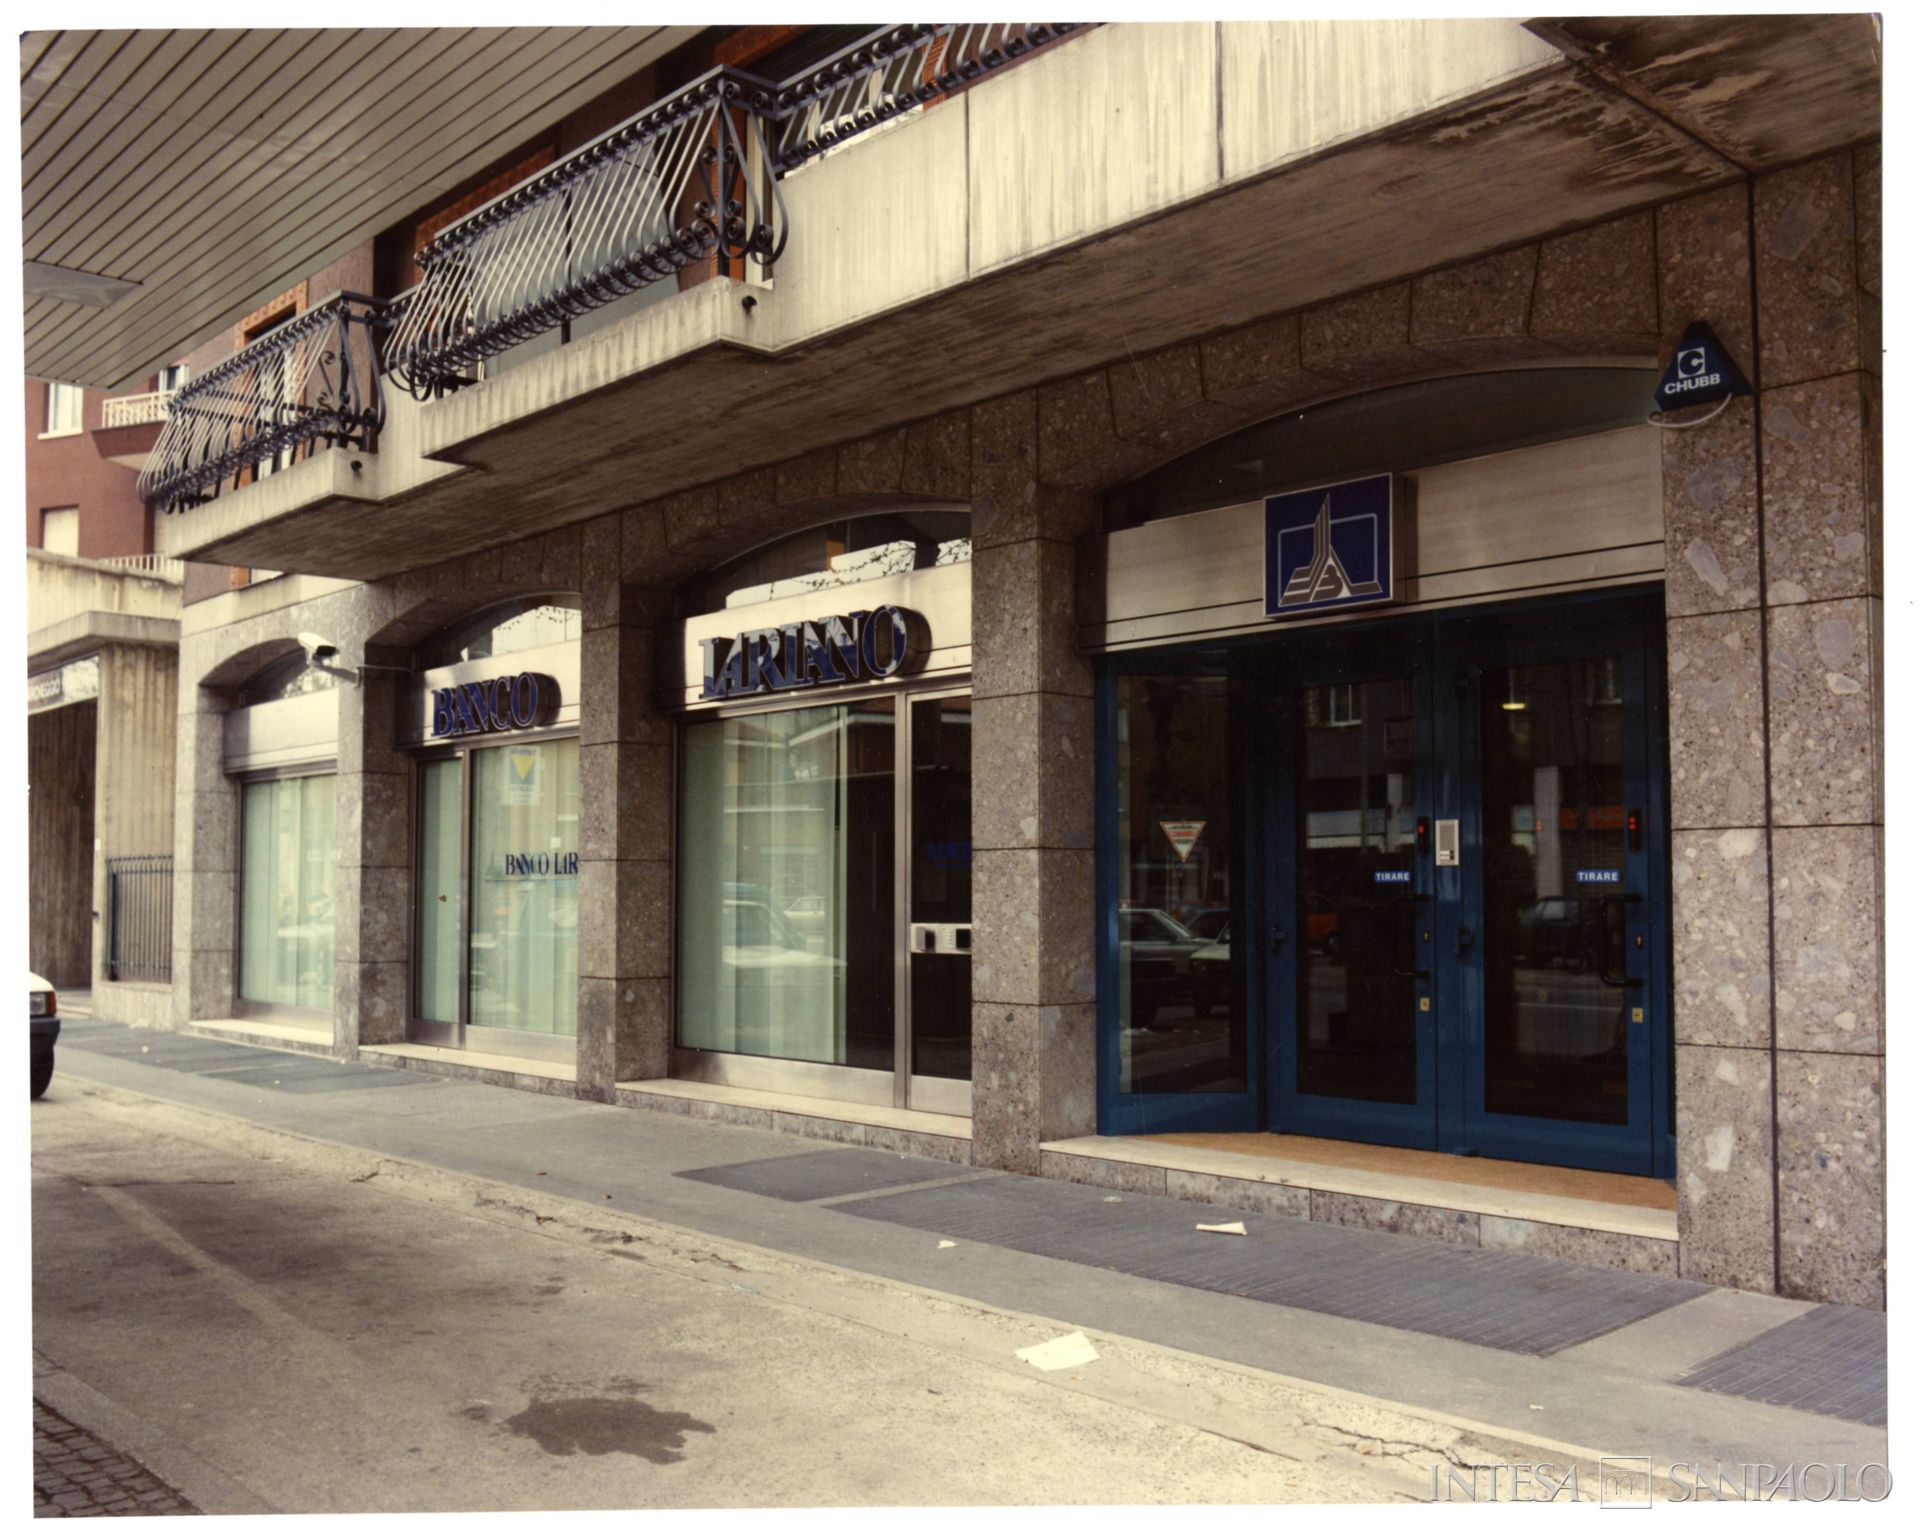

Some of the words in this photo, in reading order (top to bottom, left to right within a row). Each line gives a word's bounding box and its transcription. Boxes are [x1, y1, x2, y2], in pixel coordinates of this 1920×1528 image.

[1664, 373, 1720, 394] CHUBB
[431, 671, 539, 737] BANCO
[698, 603, 907, 699] LARIANO
[505, 852, 550, 876] BANCO
[1375, 873, 1410, 881] TIRARE
[1577, 872, 1618, 881] TIRARE
